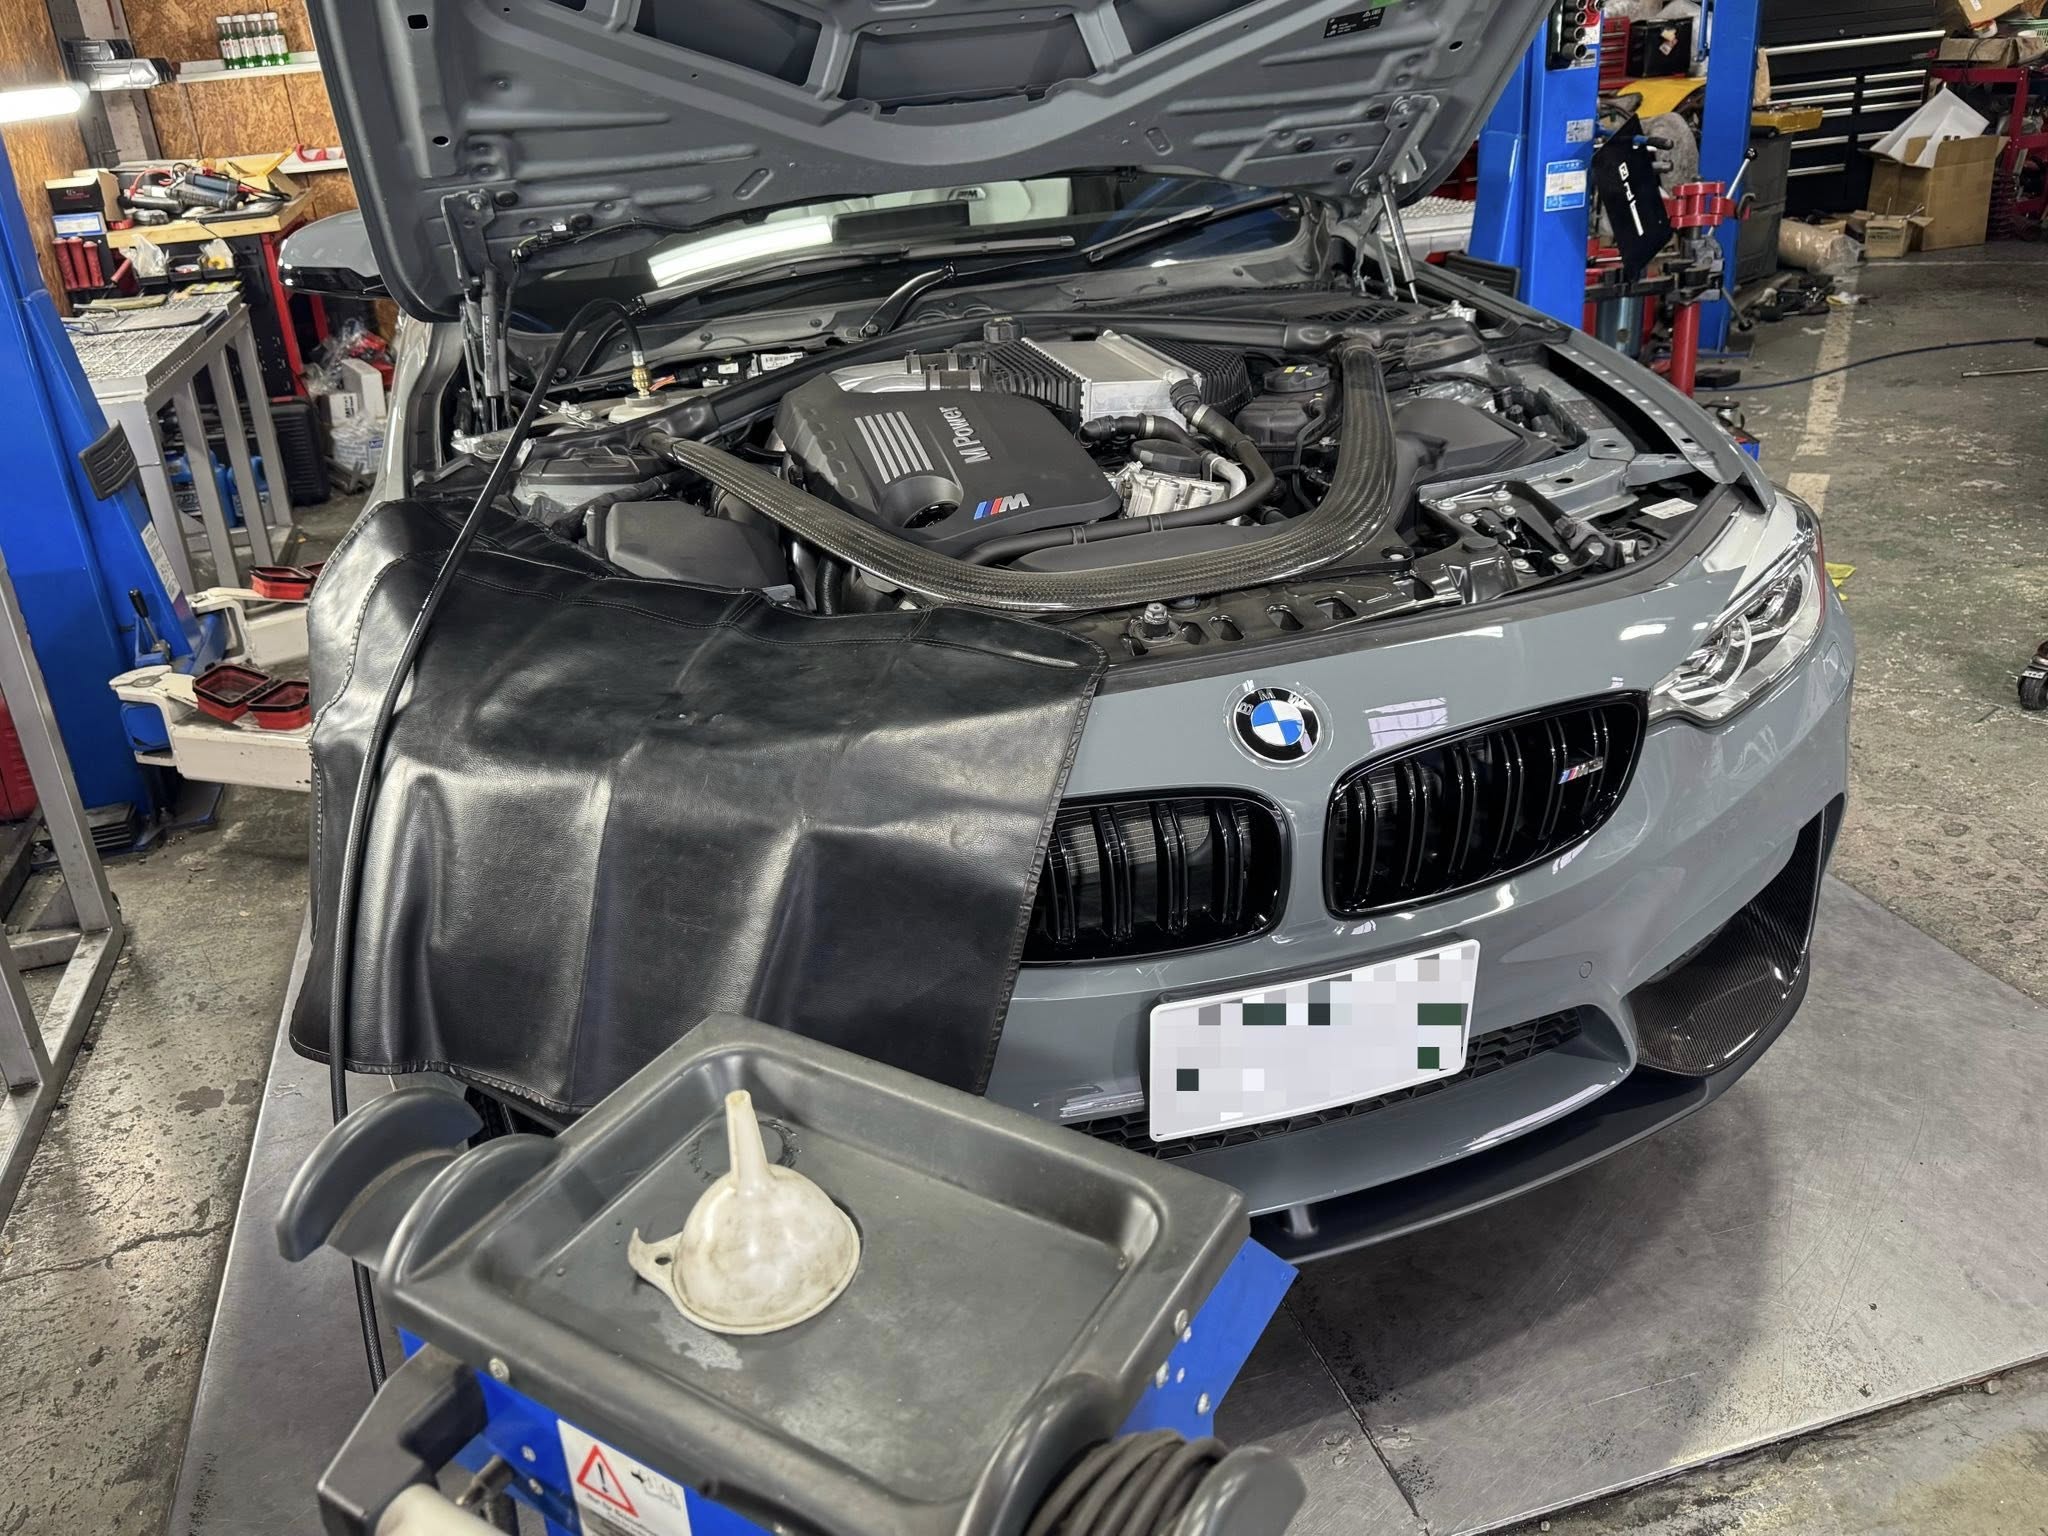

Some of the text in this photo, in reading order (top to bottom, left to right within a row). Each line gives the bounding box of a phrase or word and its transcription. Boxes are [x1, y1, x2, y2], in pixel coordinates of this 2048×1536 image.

[939, 406, 992, 464] M Power
[1237, 688, 1314, 716] BMW
